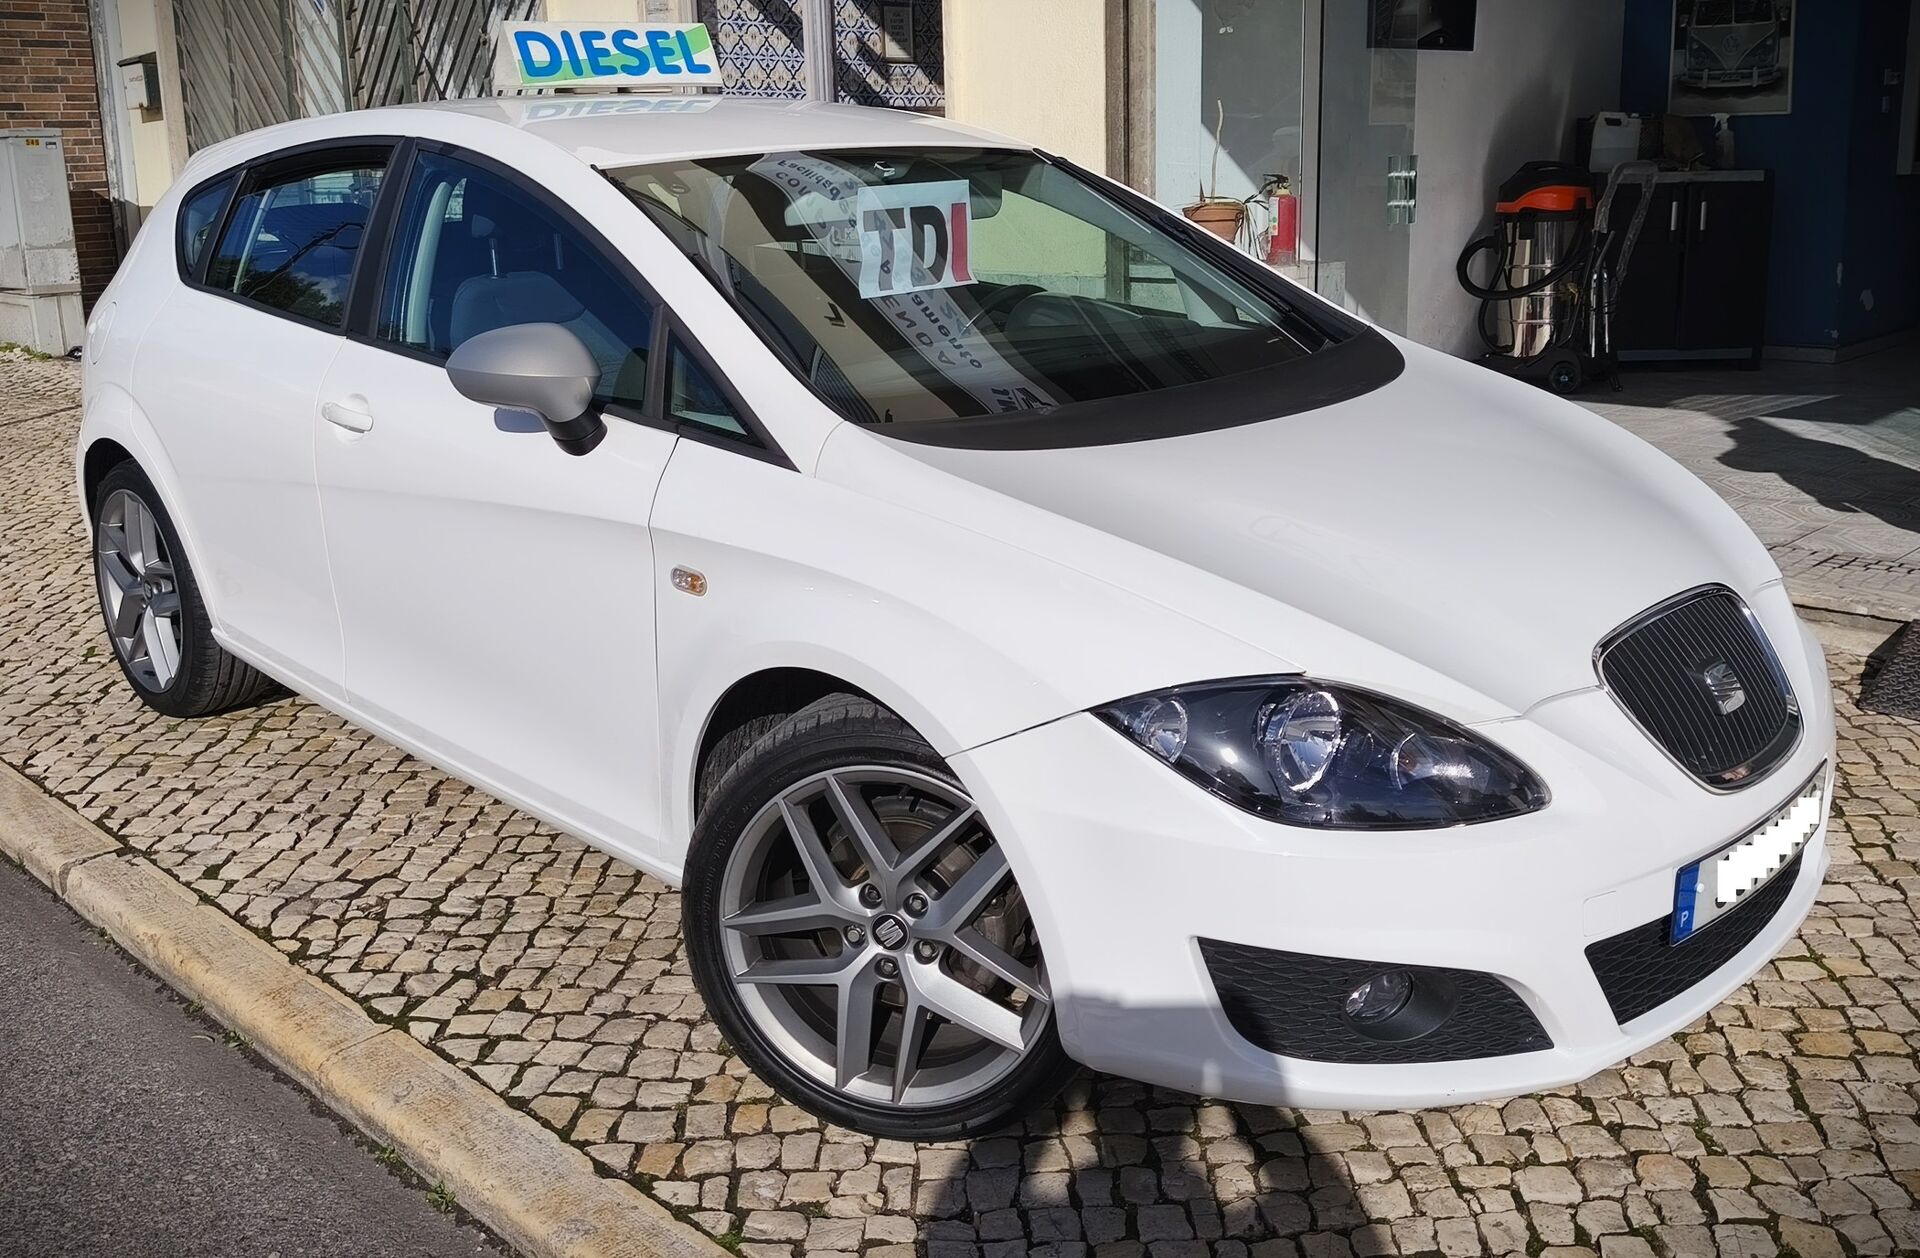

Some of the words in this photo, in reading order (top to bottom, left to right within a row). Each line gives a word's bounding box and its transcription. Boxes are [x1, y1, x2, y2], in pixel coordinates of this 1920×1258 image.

[514, 29, 712, 77] DIESEL
[863, 203, 972, 291] TDI
[1680, 911, 1689, 928] P
